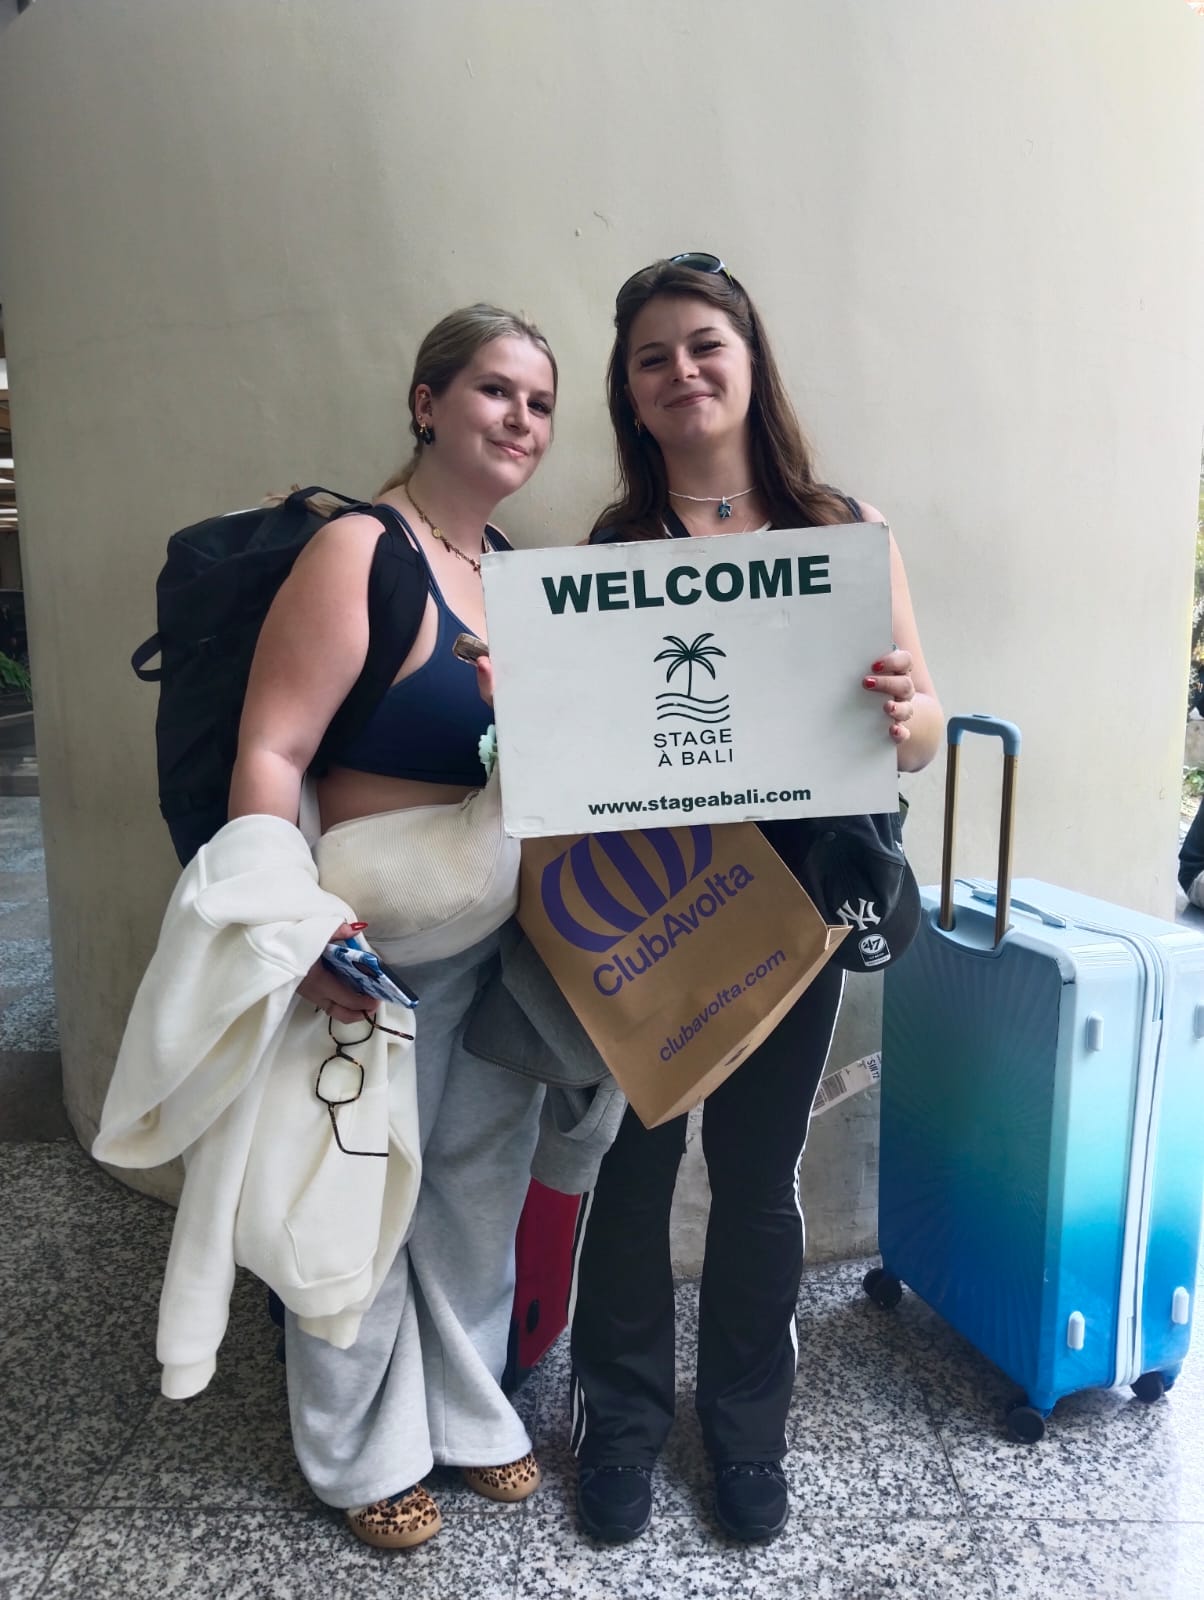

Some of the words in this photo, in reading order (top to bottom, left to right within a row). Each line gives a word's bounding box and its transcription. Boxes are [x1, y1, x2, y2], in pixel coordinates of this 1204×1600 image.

[541, 554, 832, 615] WELCOME
[653, 728, 733, 748] STAGE
[657, 749, 673, 767] À
[681, 748, 734, 766] BALI
[588, 788, 812, 816] www.stageabali.com
[592, 863, 754, 997] ClubAvolta
[659, 949, 787, 1062] clubavolta.com
